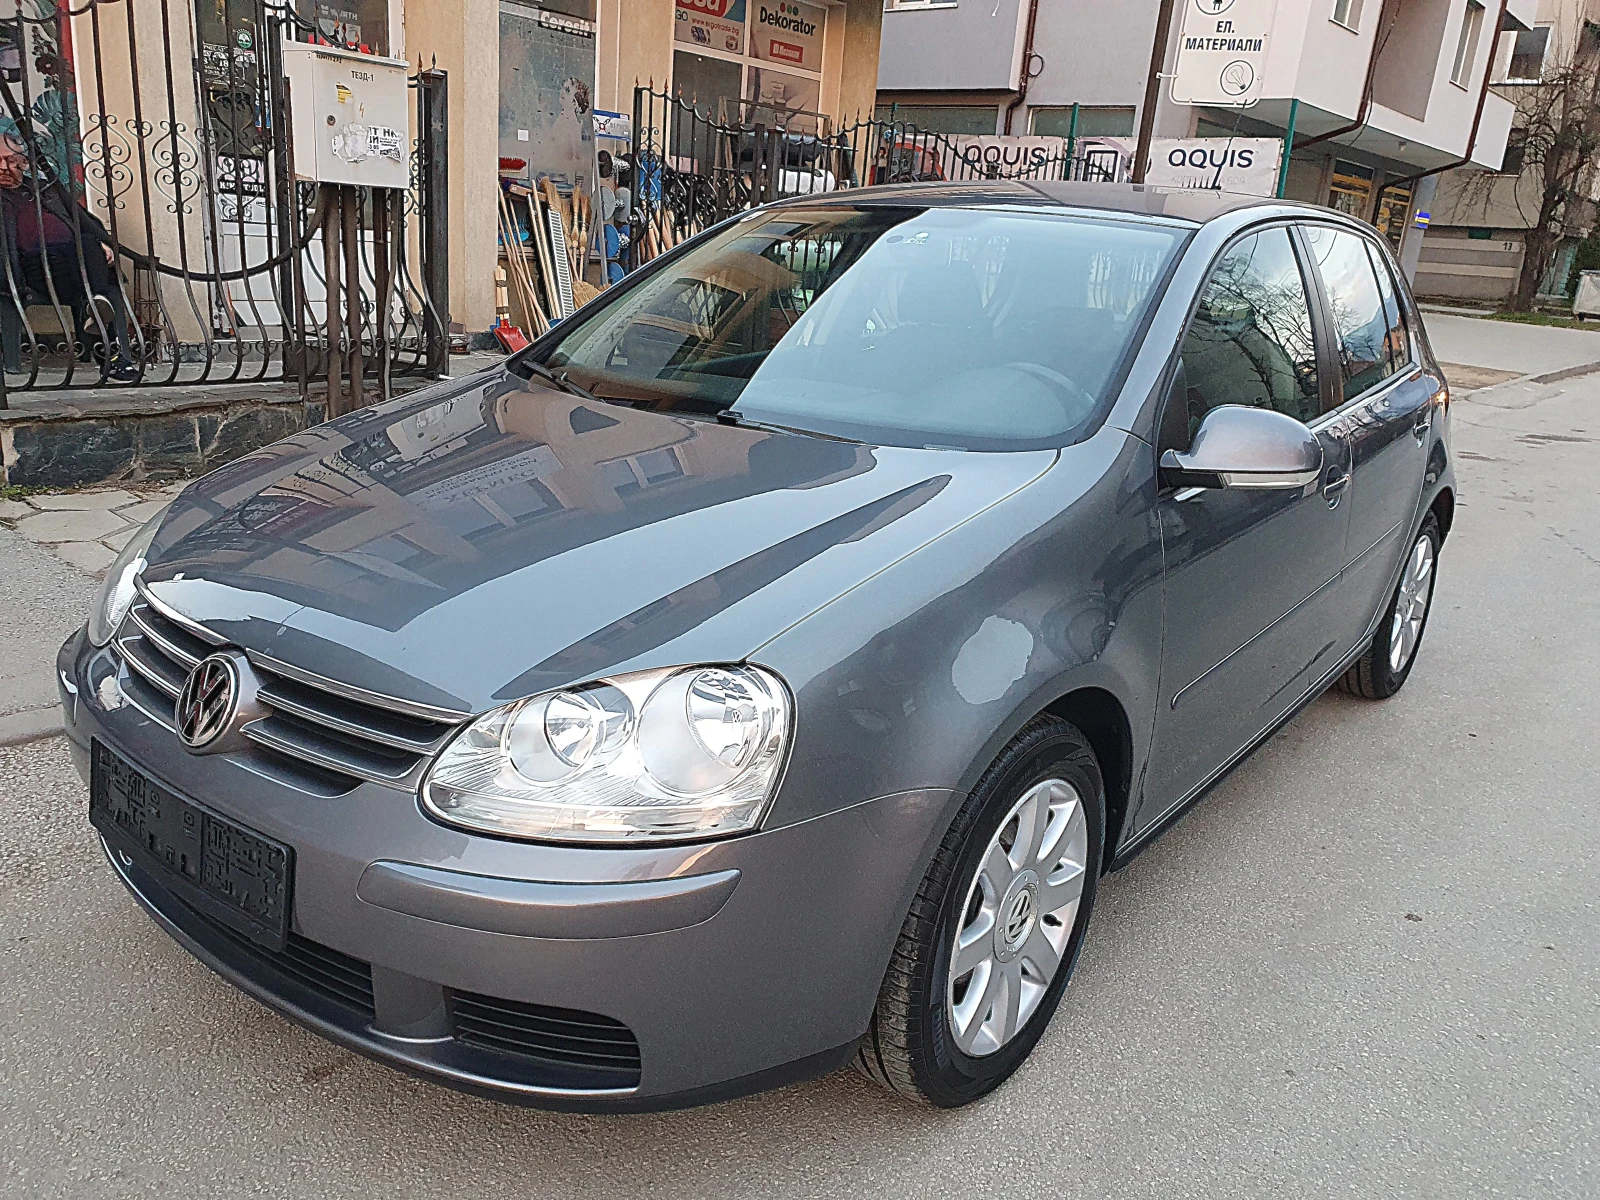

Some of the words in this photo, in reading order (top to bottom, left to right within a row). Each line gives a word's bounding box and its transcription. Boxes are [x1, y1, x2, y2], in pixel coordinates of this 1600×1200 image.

[759, 6, 817, 36] Dekorator
[1215, 20, 1236, 34] ЕЛ.
[1184, 37, 1263, 52] МАТЕРИАЛИ
[351, 70, 375, 82] ТЕЗД-1
[1502, 242, 1513, 251] 13
